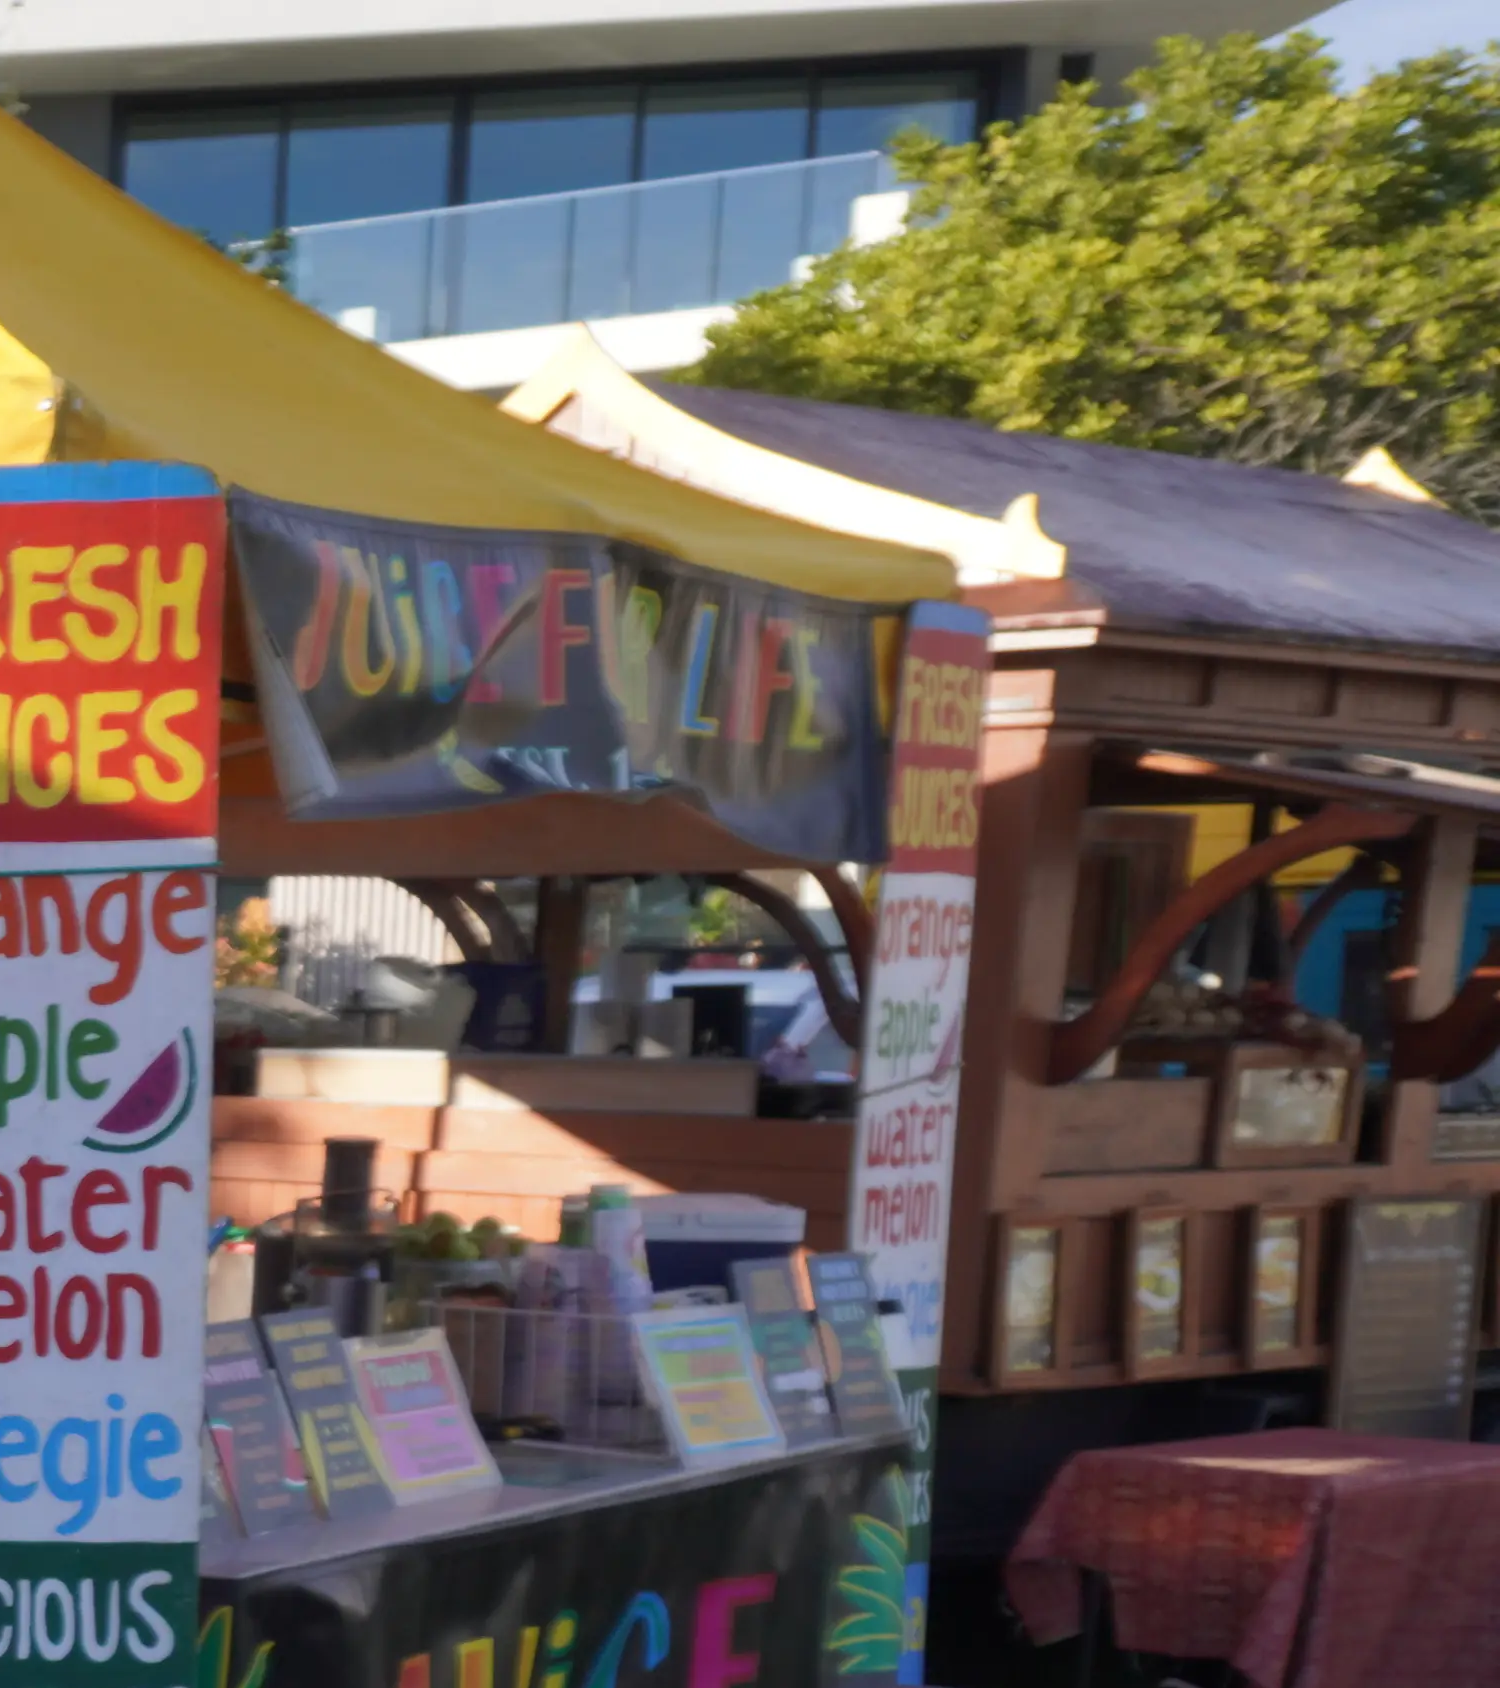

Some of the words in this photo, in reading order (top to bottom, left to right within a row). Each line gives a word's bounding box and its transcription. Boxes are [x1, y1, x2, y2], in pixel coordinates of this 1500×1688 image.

[902, 655, 982, 748] FRESH
[891, 772, 981, 849] JUICES
[877, 896, 972, 991] orange
[877, 987, 941, 1078] apple
[865, 1101, 953, 1168] water
[864, 1178, 940, 1246] melon
